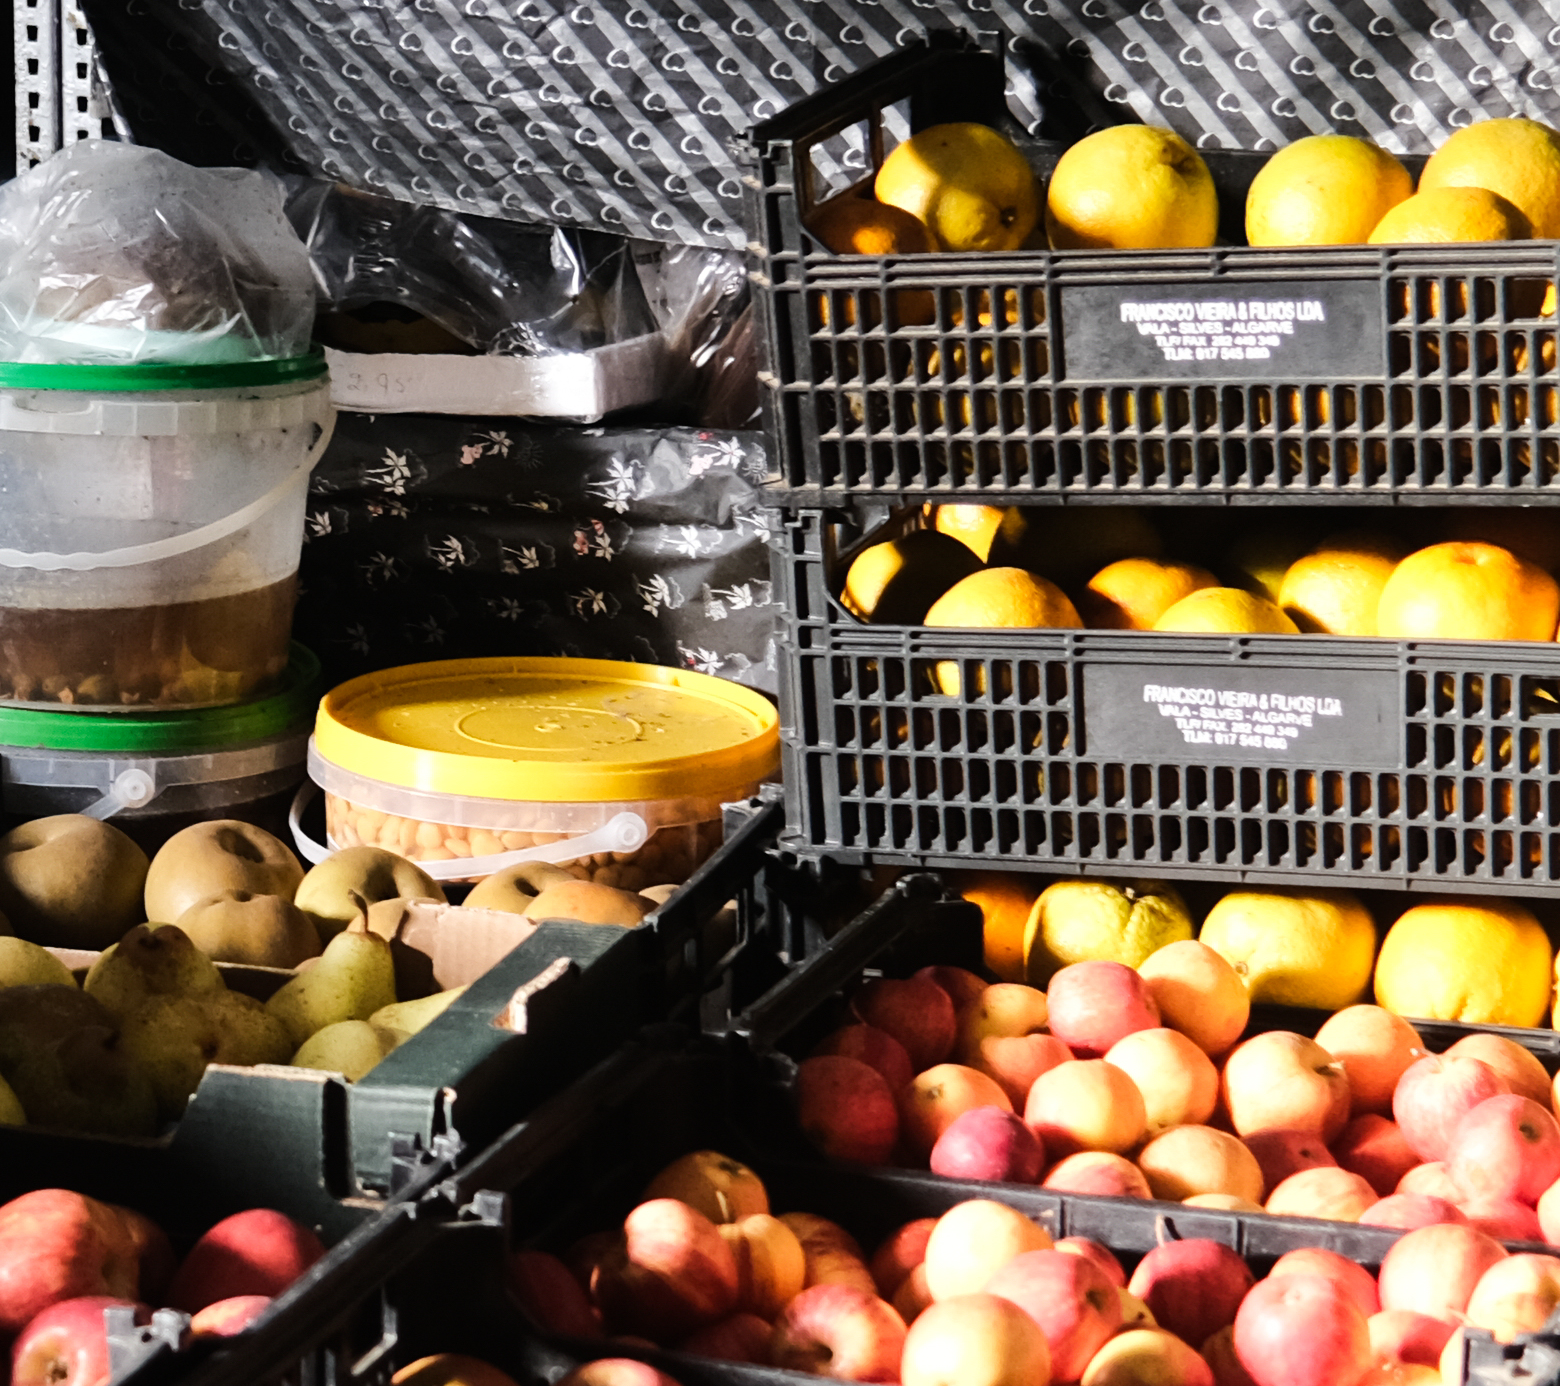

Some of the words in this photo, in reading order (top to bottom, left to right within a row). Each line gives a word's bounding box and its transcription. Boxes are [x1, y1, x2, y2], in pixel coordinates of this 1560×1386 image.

[1121, 302, 1194, 322] FRANCISCO
[1195, 302, 1237, 321] VIEIRA
[1238, 302, 1248, 320] &
[1250, 301, 1295, 321] FILHOS
[1296, 301, 1325, 321] LDA
[1136, 322, 1171, 335] VALA
[1179, 322, 1223, 334] SILVES
[1231, 321, 1295, 334] ALGARVE
[1143, 684, 1215, 706] FRANCISCO
[1218, 691, 1258, 708] VIEIRA
[1259, 693, 1269, 709] &
[1271, 693, 1316, 713] FILHOS
[1317, 698, 1343, 717] LDA
[1157, 704, 1192, 717] VALA
[1200, 707, 1244, 721] SILVES
[1251, 711, 1314, 727] ALGARVE
